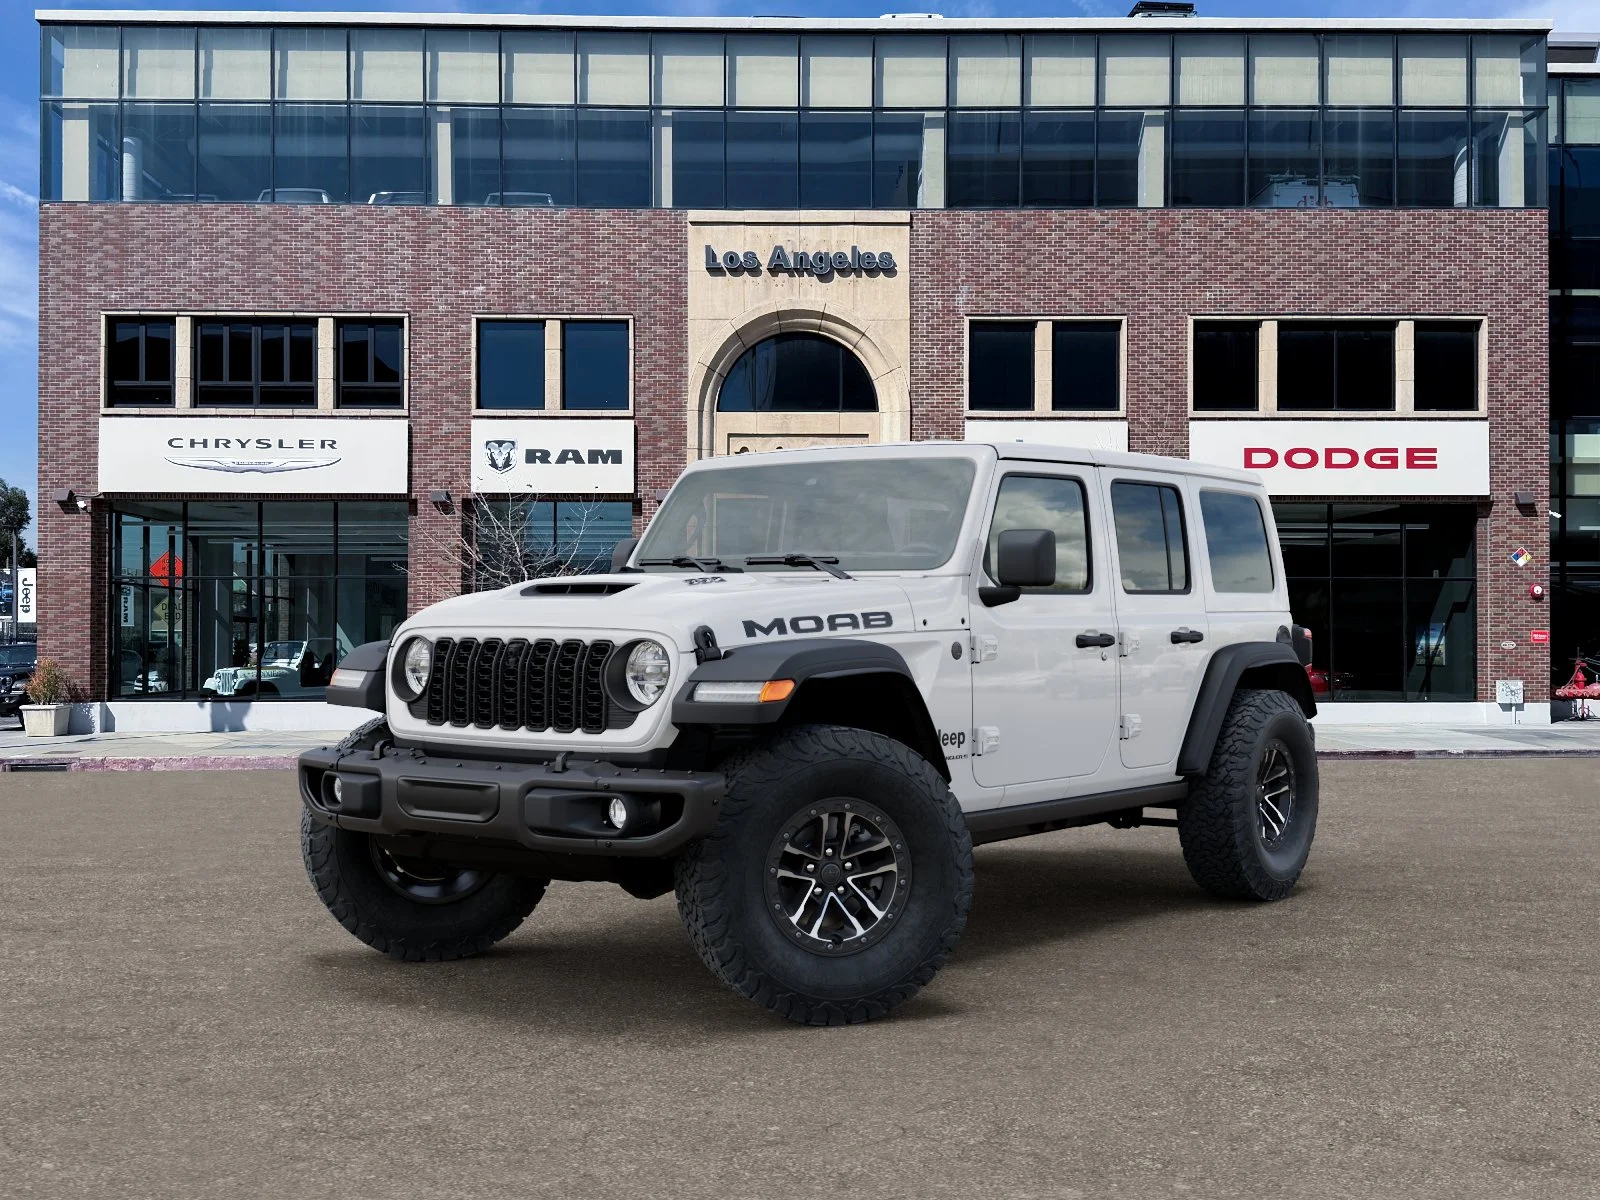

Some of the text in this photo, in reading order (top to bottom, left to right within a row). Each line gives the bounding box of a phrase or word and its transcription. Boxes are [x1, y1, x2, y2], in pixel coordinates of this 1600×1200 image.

[704, 244, 895, 275] Los Angeles
[167, 437, 338, 450] CHRYSLER
[524, 448, 623, 465] RAM
[1243, 447, 1438, 470] DODGE
[20, 577, 34, 614] Jeep
[741, 611, 894, 638] MOAB
